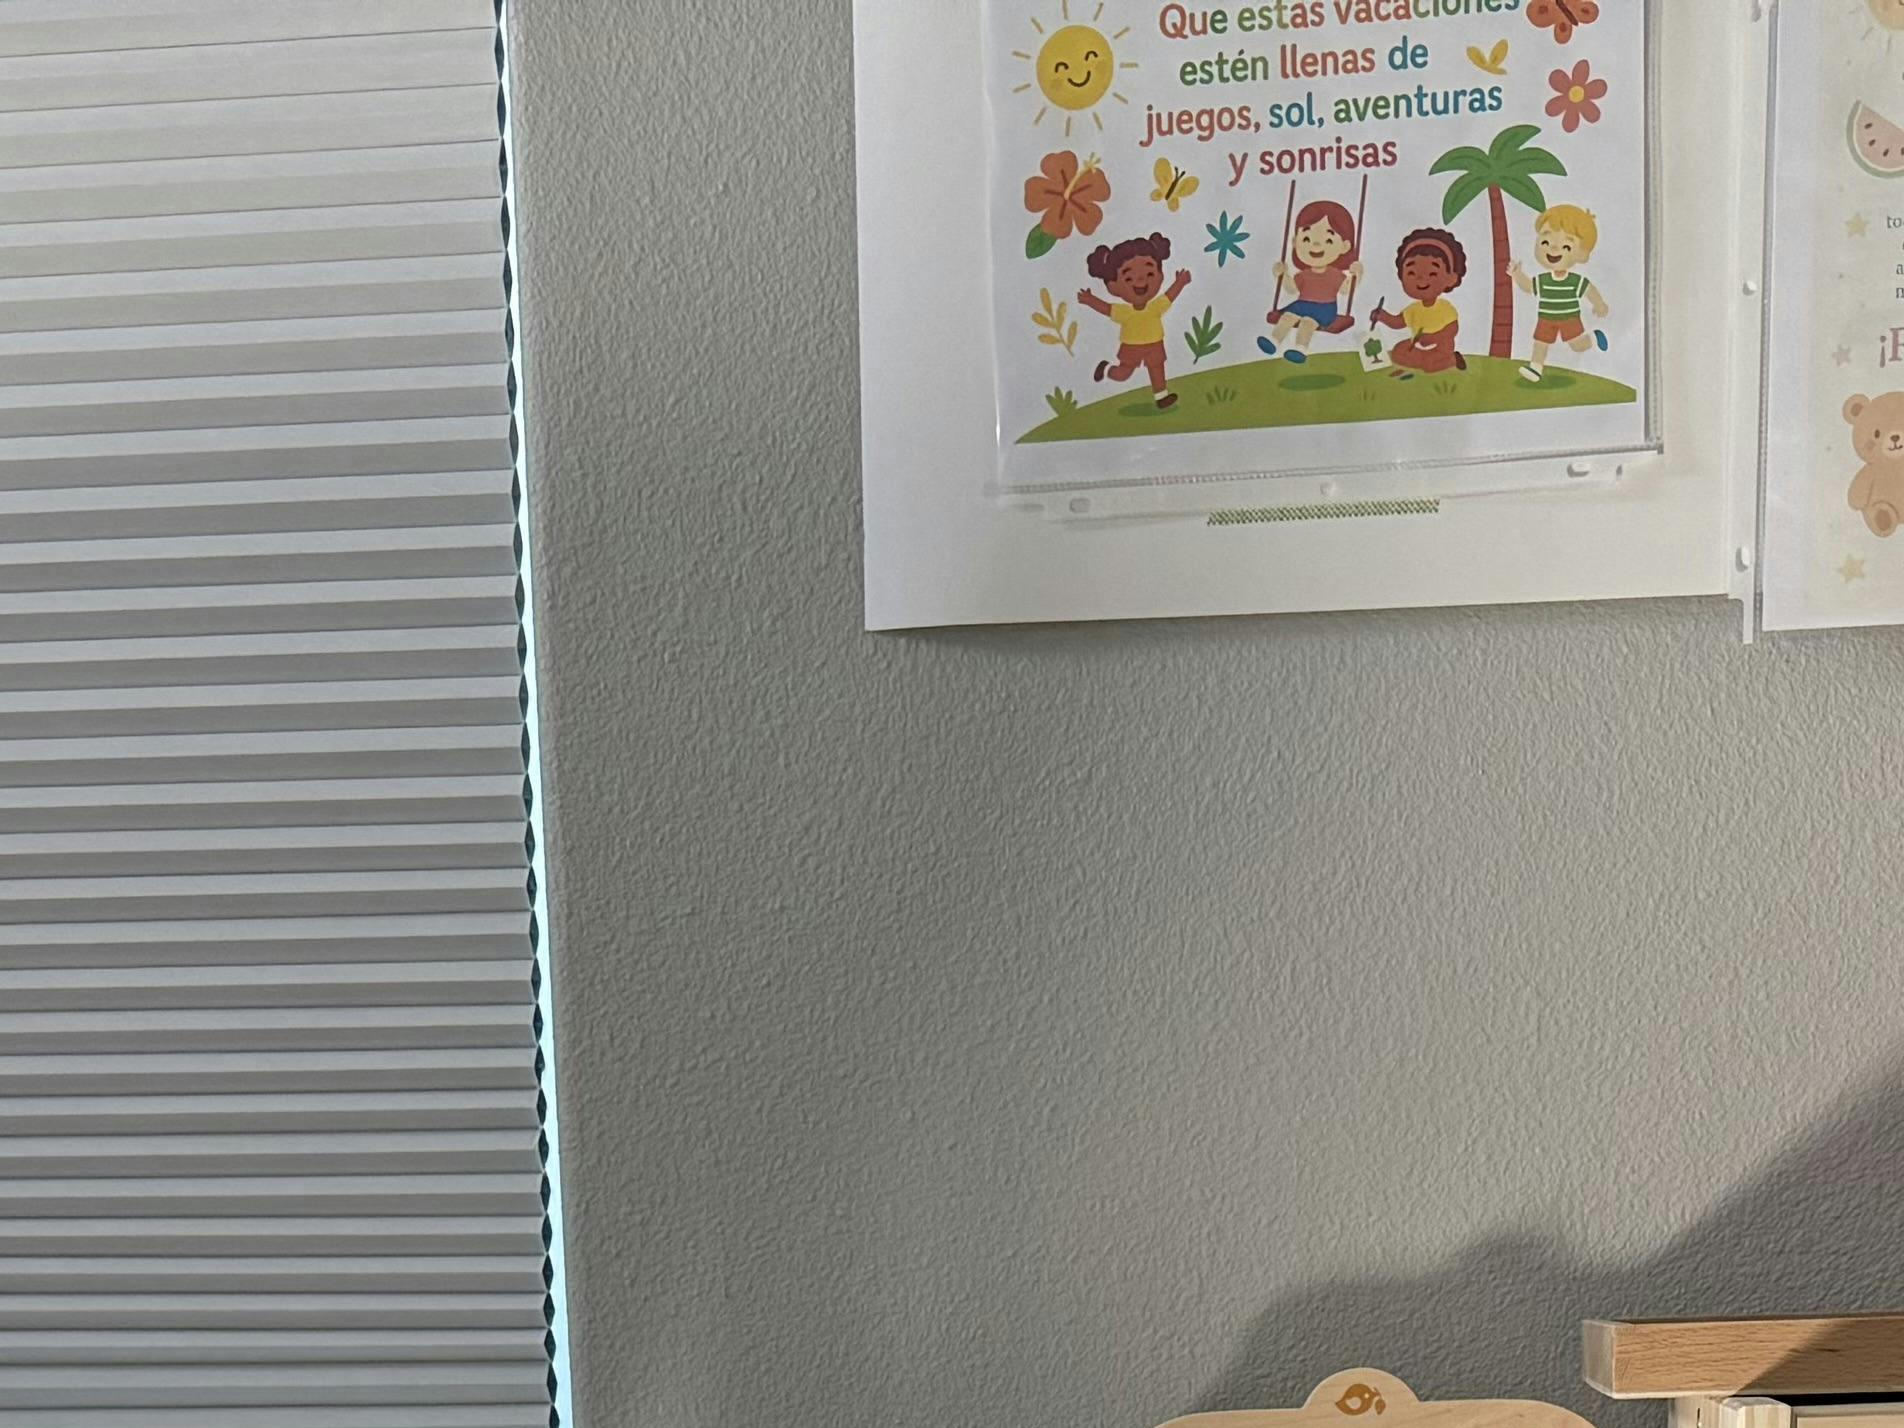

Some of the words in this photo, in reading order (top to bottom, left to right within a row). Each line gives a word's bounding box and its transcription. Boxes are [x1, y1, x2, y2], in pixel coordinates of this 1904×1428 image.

[1159, 3, 1228, 40] Que
[1237, 0, 1325, 33] estas
[1180, 49, 1269, 86] estén
[1280, 43, 1376, 80] llenas
[1388, 35, 1429, 70] de
[1138, 105, 1261, 148] juegos,
[1268, 91, 1325, 129] sol,
[1333, 84, 1503, 124] aventuras
[1228, 152, 1249, 187] y
[1259, 136, 1398, 175] sonrisas
